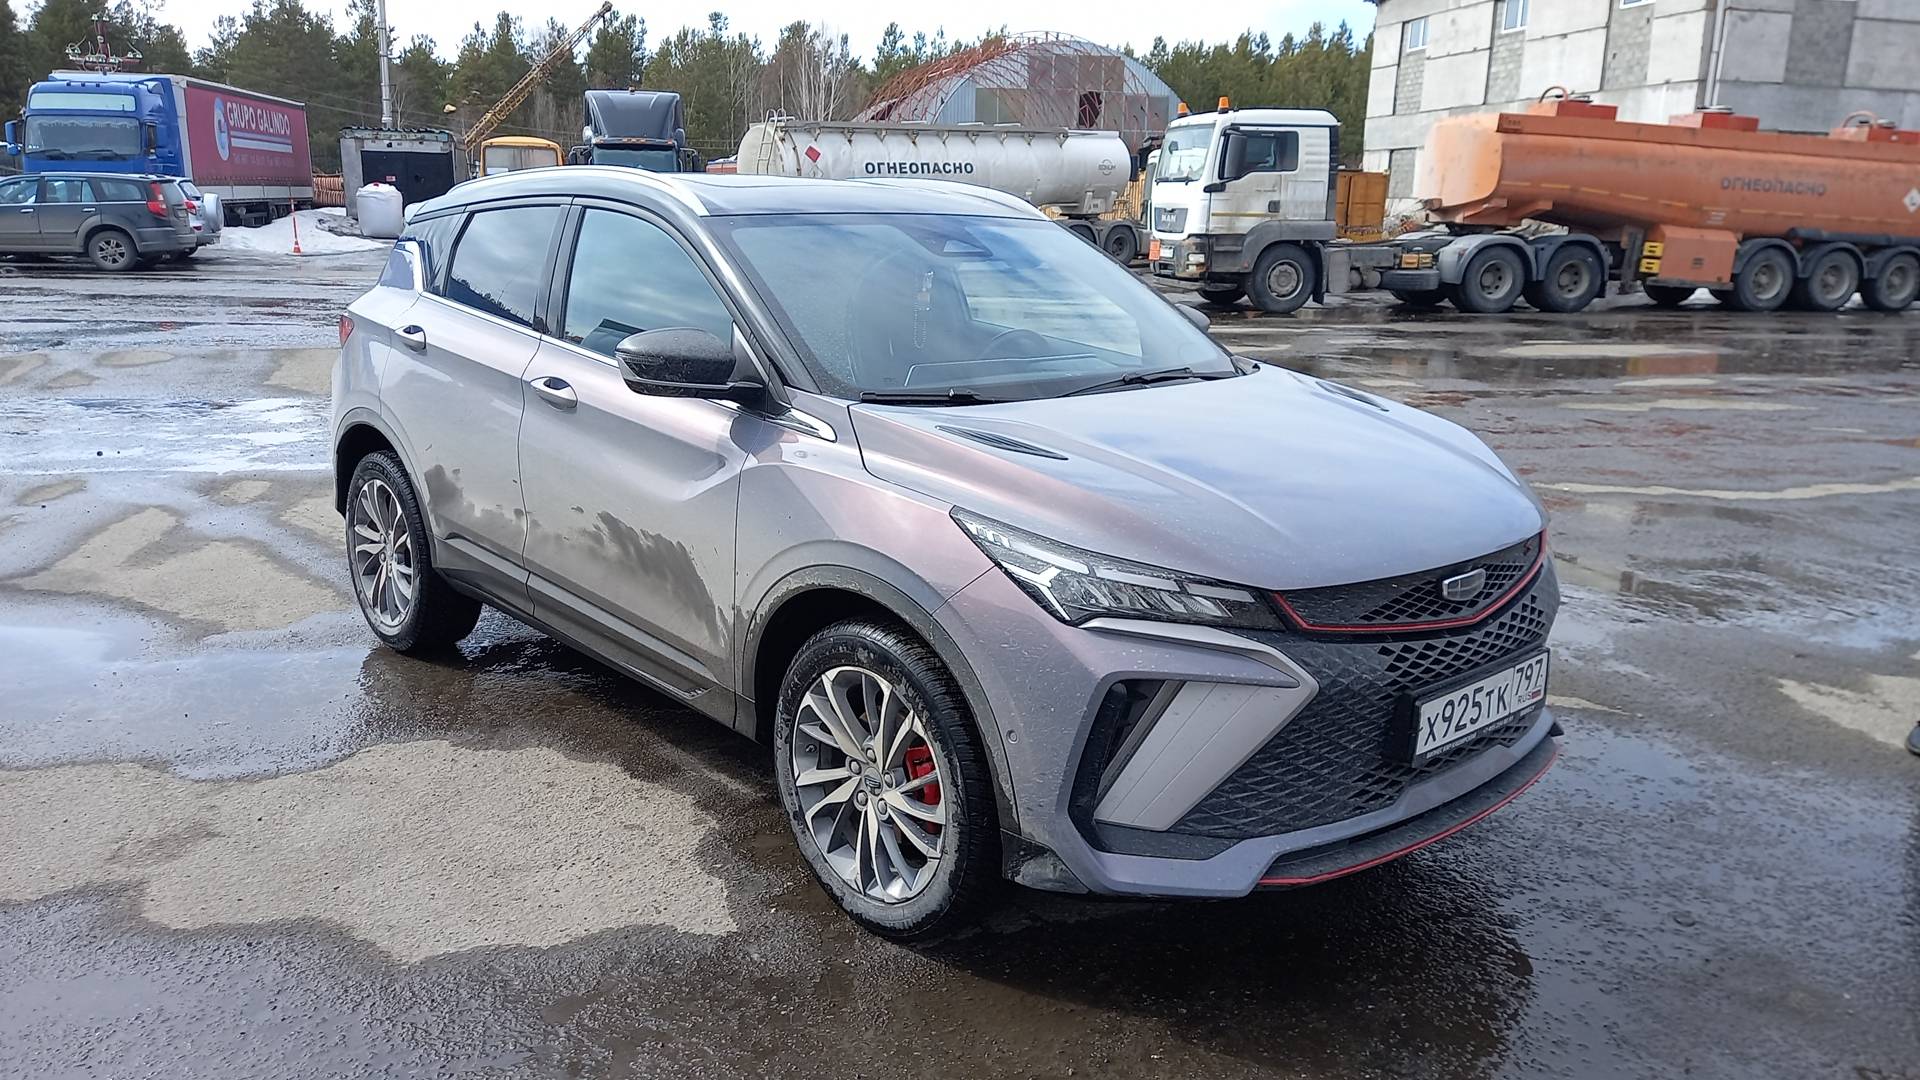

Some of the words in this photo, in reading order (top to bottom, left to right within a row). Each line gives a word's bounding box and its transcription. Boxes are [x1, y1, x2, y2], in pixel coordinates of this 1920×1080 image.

[227, 102, 256, 130] GRUPO
[257, 108, 291, 135] GALINDO
[865, 162, 974, 174] ОГНЕОПАСНО
[1720, 176, 1827, 197] ОГНЕОПАСНО
[1161, 214, 1177, 222] MAN
[1515, 658, 1543, 696] 797
